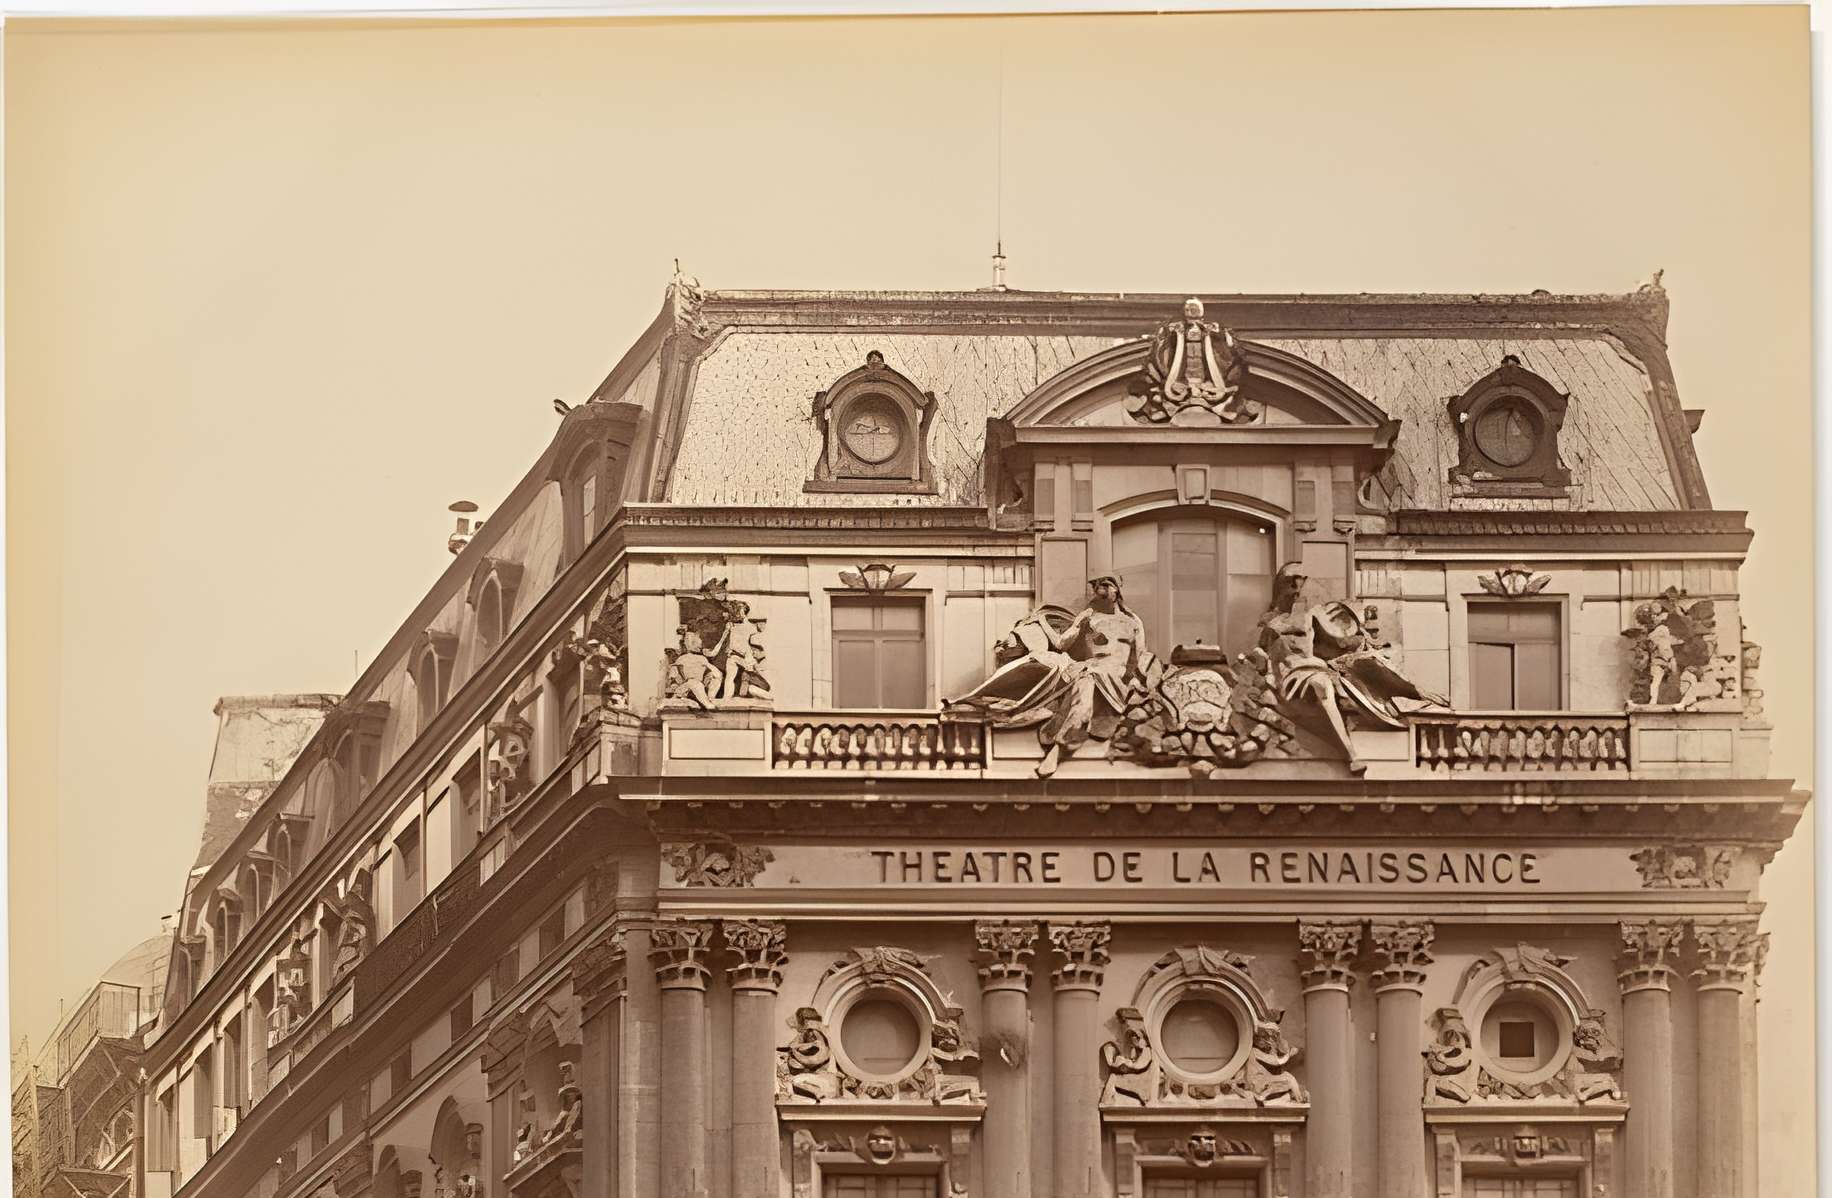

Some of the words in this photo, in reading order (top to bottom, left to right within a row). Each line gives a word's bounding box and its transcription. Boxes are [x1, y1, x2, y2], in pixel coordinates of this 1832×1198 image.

[870, 850, 1061, 884] THEATRE
[1093, 851, 1143, 884] DE
[1172, 851, 1221, 884] LA
[1250, 851, 1541, 884] RENAISSANCE
